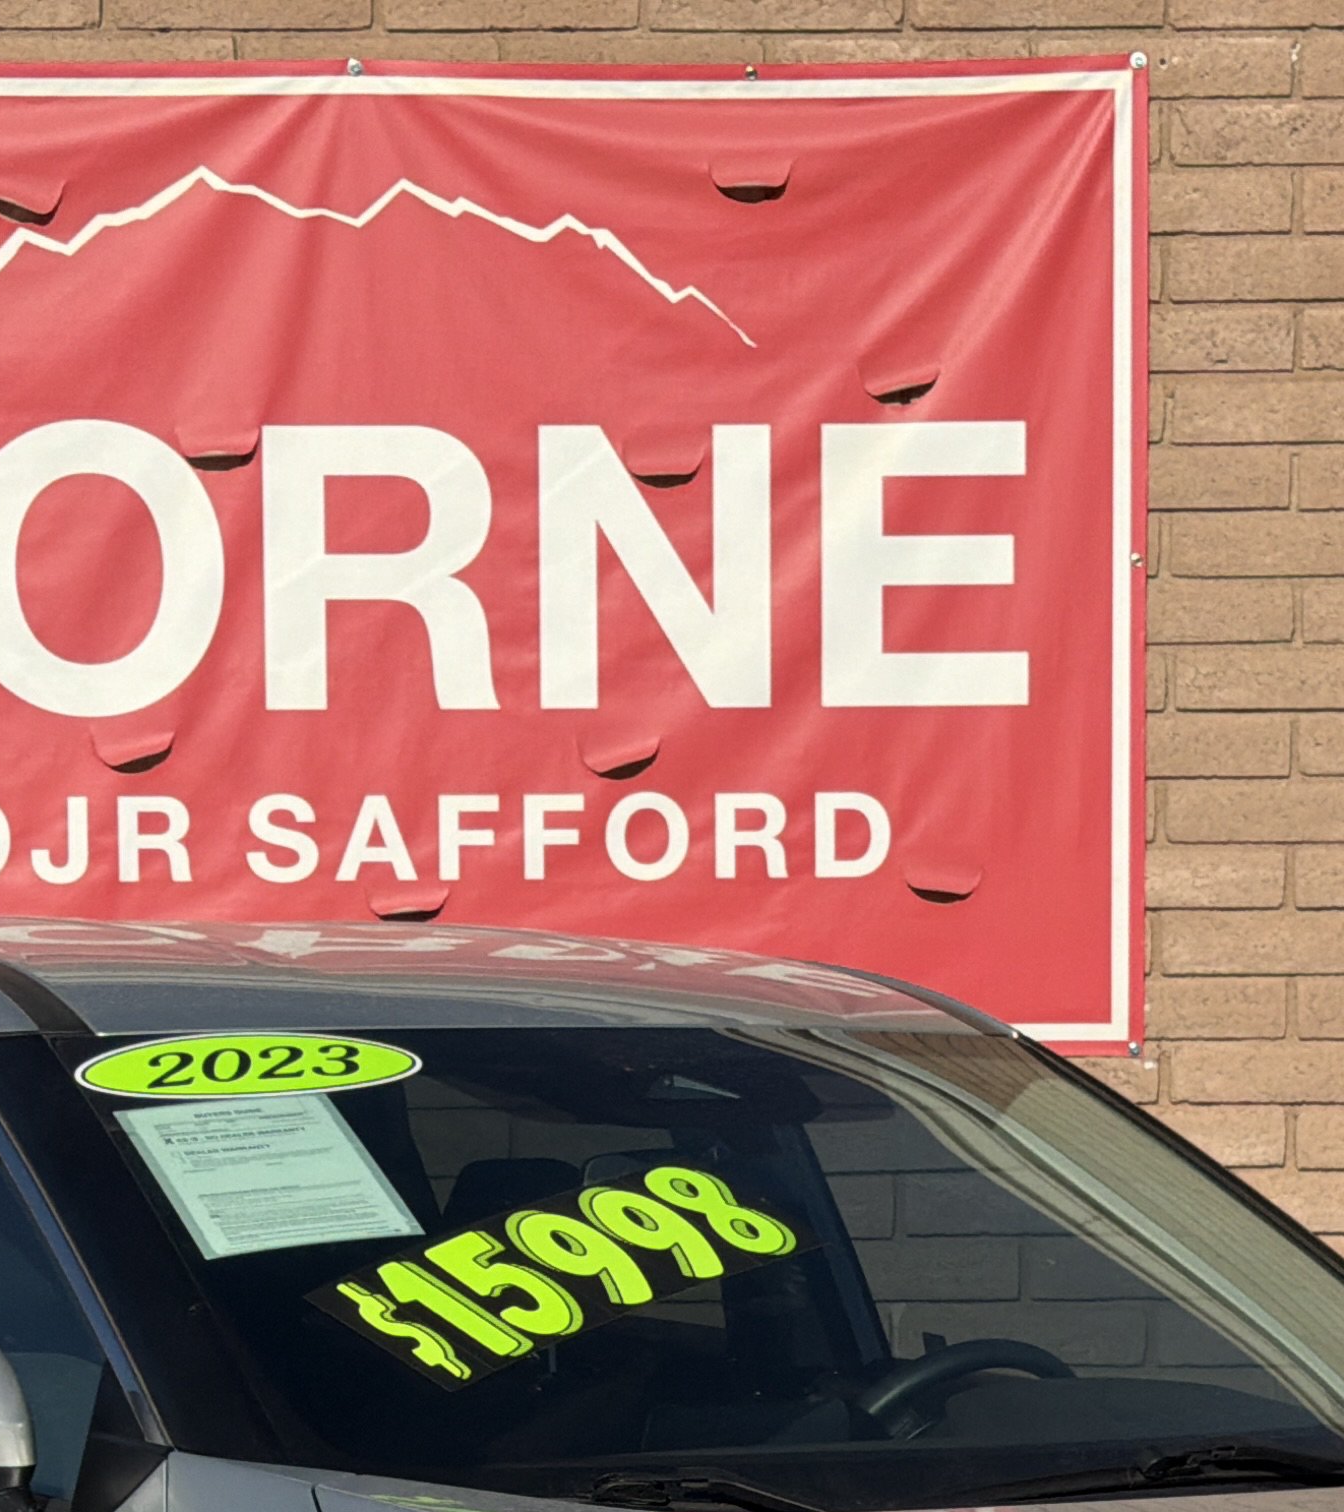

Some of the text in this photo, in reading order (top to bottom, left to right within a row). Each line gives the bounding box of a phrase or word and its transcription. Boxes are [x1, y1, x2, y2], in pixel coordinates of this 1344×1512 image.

[246, 790, 892, 885] SAFFORD
[147, 1044, 360, 1089] 2023
[336, 1166, 798, 1380] $15998
